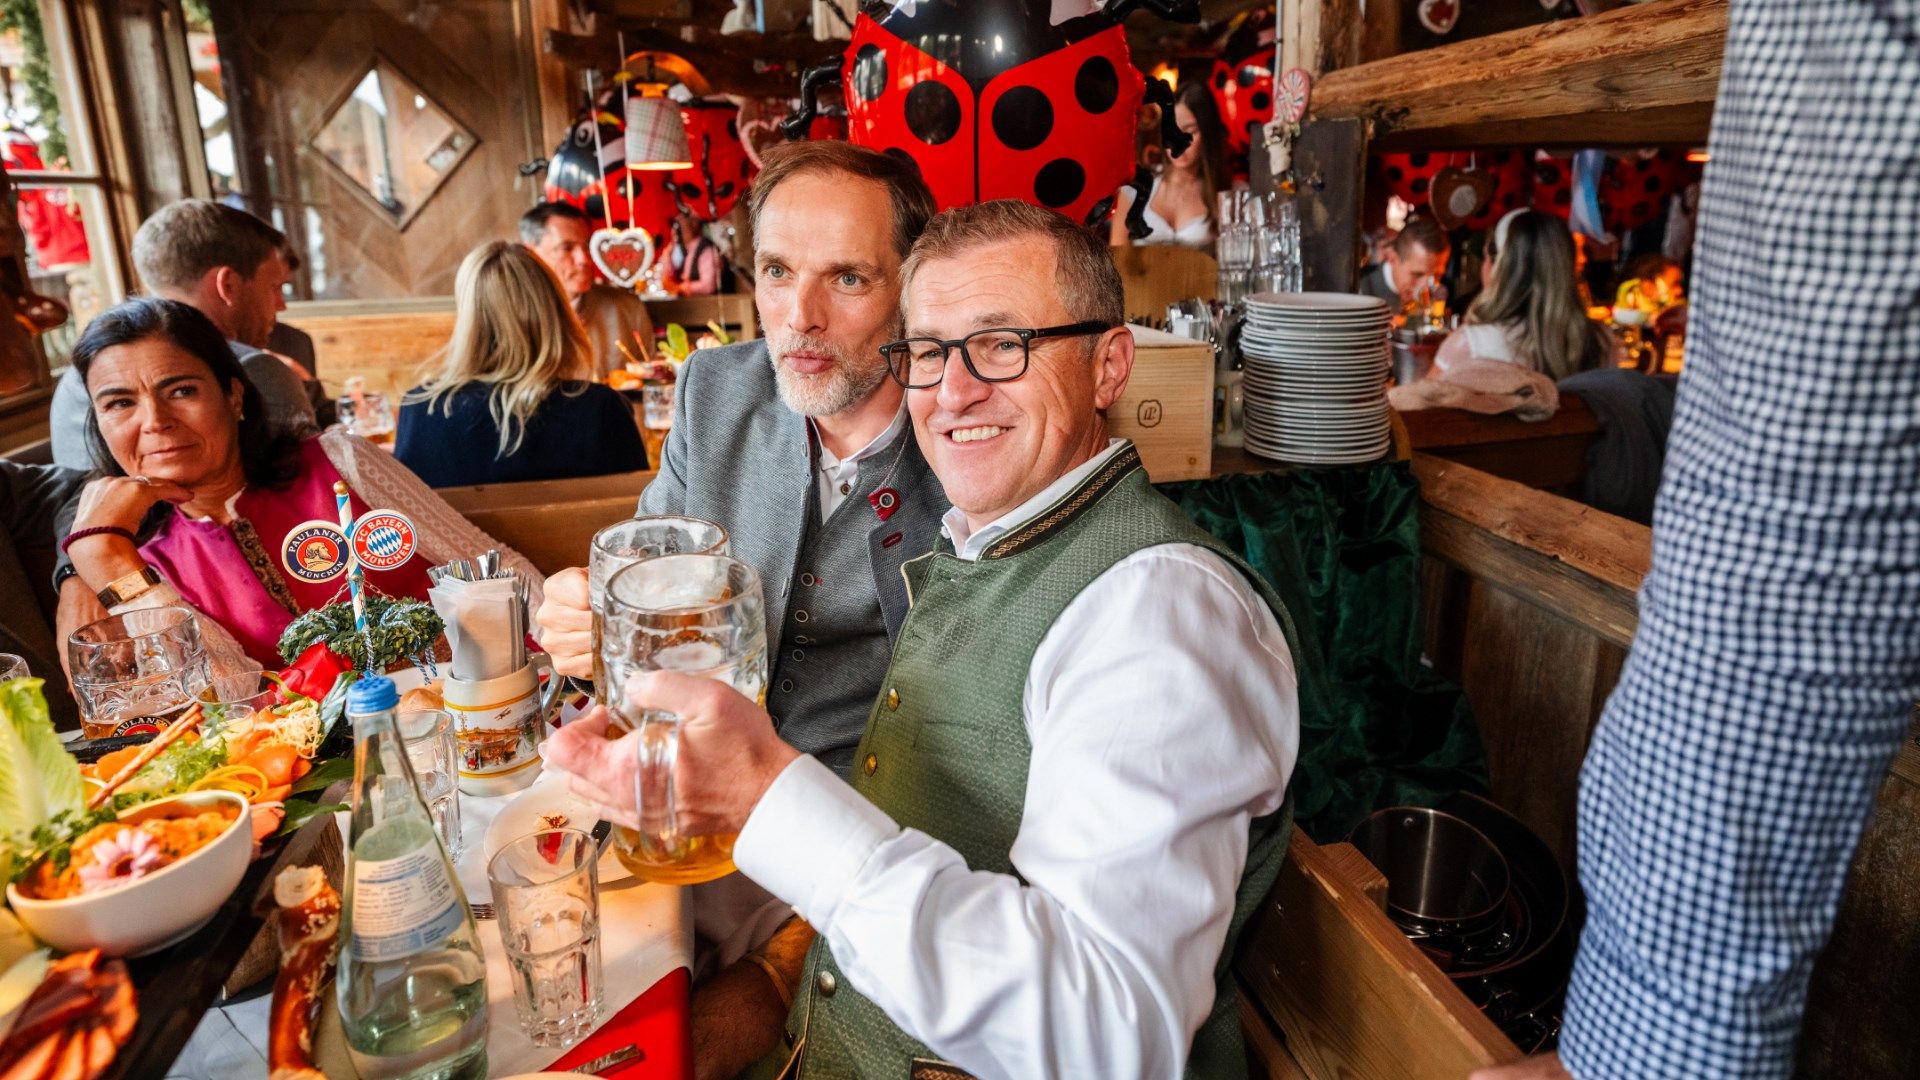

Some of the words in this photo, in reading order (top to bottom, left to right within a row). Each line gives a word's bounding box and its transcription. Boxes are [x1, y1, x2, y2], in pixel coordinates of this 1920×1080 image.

[288, 528, 343, 553] PAULANER
[357, 528, 369, 542] FC
[367, 517, 409, 535] BAYERN
[361, 542, 412, 566] MÜNCHEN
[297, 561, 344, 579] MÜNCHEN
[114, 717, 168, 737] PAULAN
